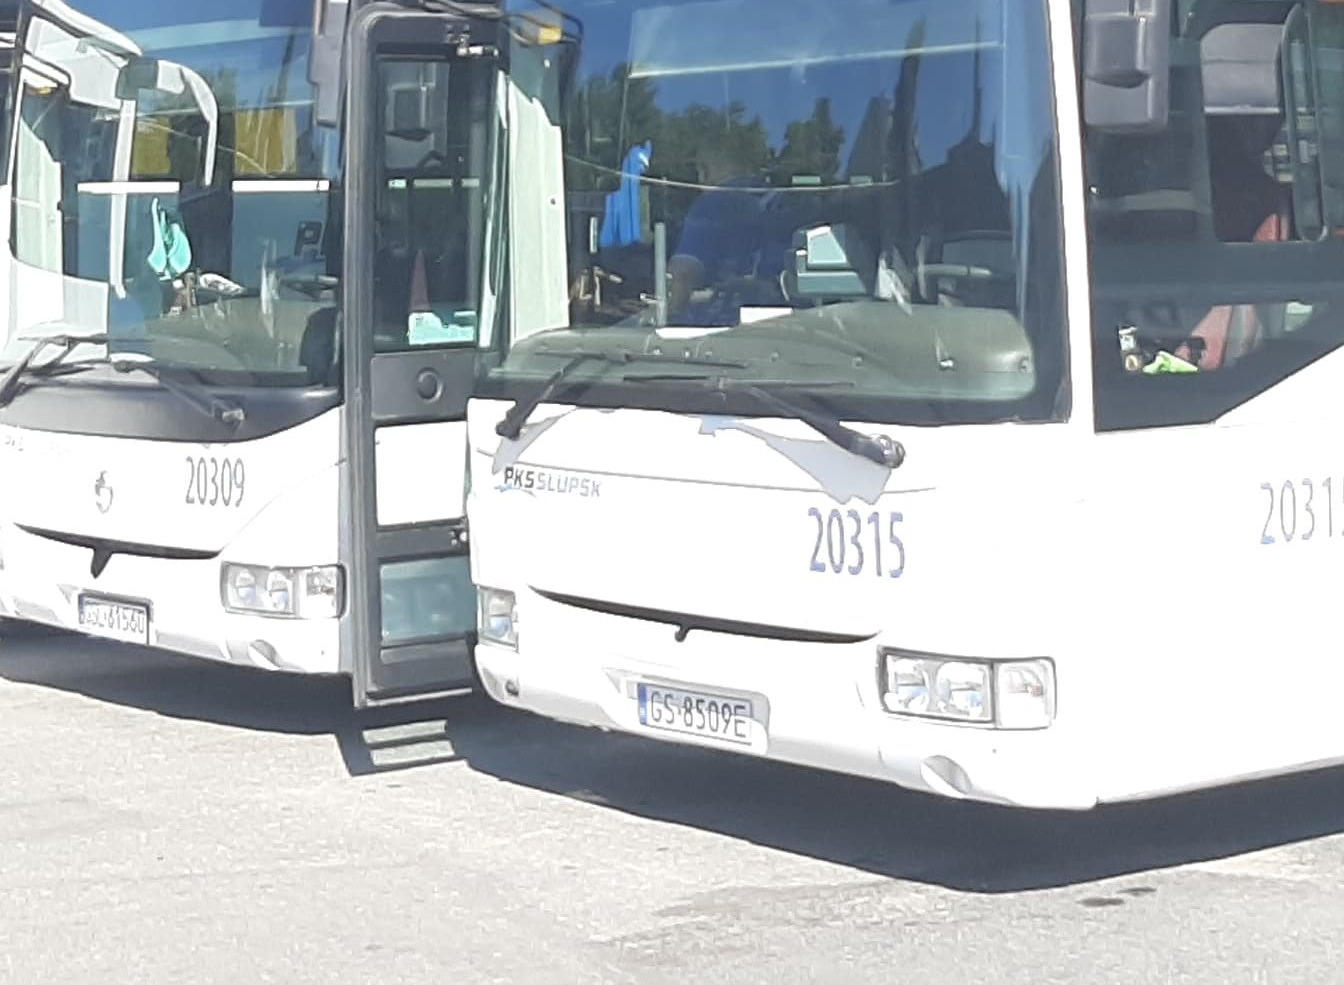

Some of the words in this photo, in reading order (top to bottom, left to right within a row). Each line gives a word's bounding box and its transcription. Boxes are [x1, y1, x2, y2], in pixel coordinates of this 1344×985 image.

[185, 456, 246, 508] 20309
[504, 467, 535, 488] PKS
[807, 507, 905, 578] 20315
